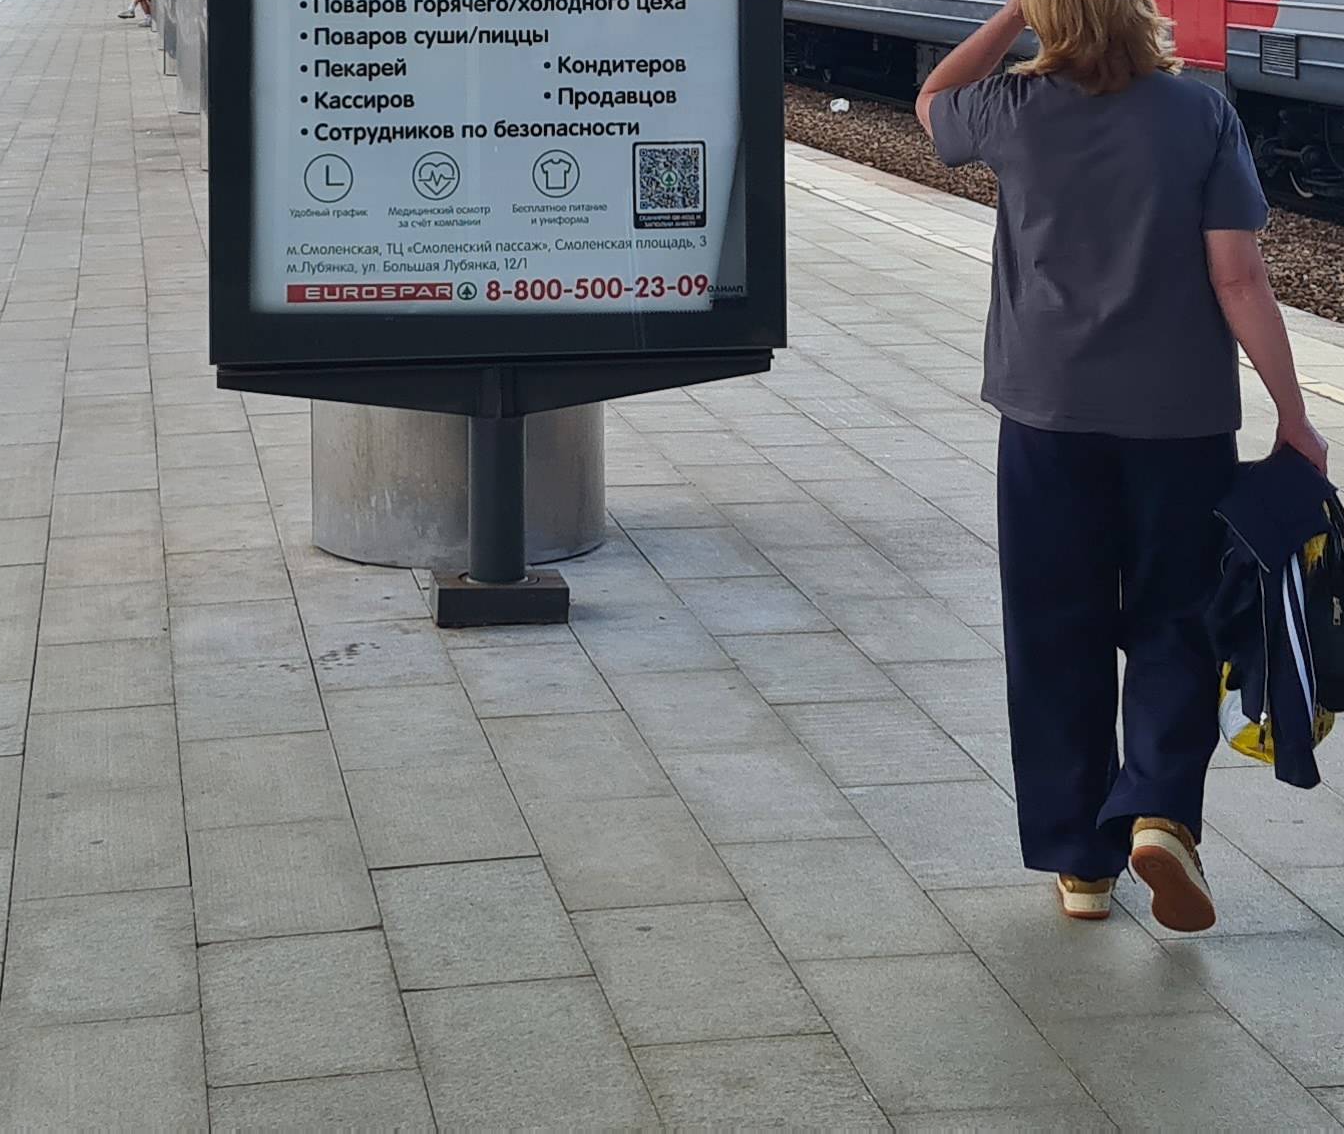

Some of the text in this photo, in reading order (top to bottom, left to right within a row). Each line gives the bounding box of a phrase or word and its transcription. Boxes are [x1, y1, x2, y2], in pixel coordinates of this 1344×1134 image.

[314, 25, 549, 50] Поваров суши/пиццы
[314, 57, 407, 82] Пекарей
[557, 55, 687, 78] Кондитеров
[314, 91, 415, 113] Кассиров
[558, 86, 678, 110] Продавцов
[314, 119, 640, 145] Сотрудников по безопасности
[289, 207, 369, 219] Удобный график
[387, 205, 491, 217] Медицинский осмотр
[511, 203, 608, 213] Бесплатное питание
[397, 219, 409, 228] за
[434, 218, 481, 228] компании
[530, 216, 590, 227] и униформа
[285, 235, 708, 257] м.Смоленская, ТЦ «Смоленский пассаж», Смоленская площадь, 3
[383, 260, 440, 273] Большая
[443, 258, 500, 274] Лубянка,
[504, 256, 528, 270] 12/1
[305, 284, 452, 300] EUROSPAR
[485, 273, 709, 302] 8-800-500-23-09
